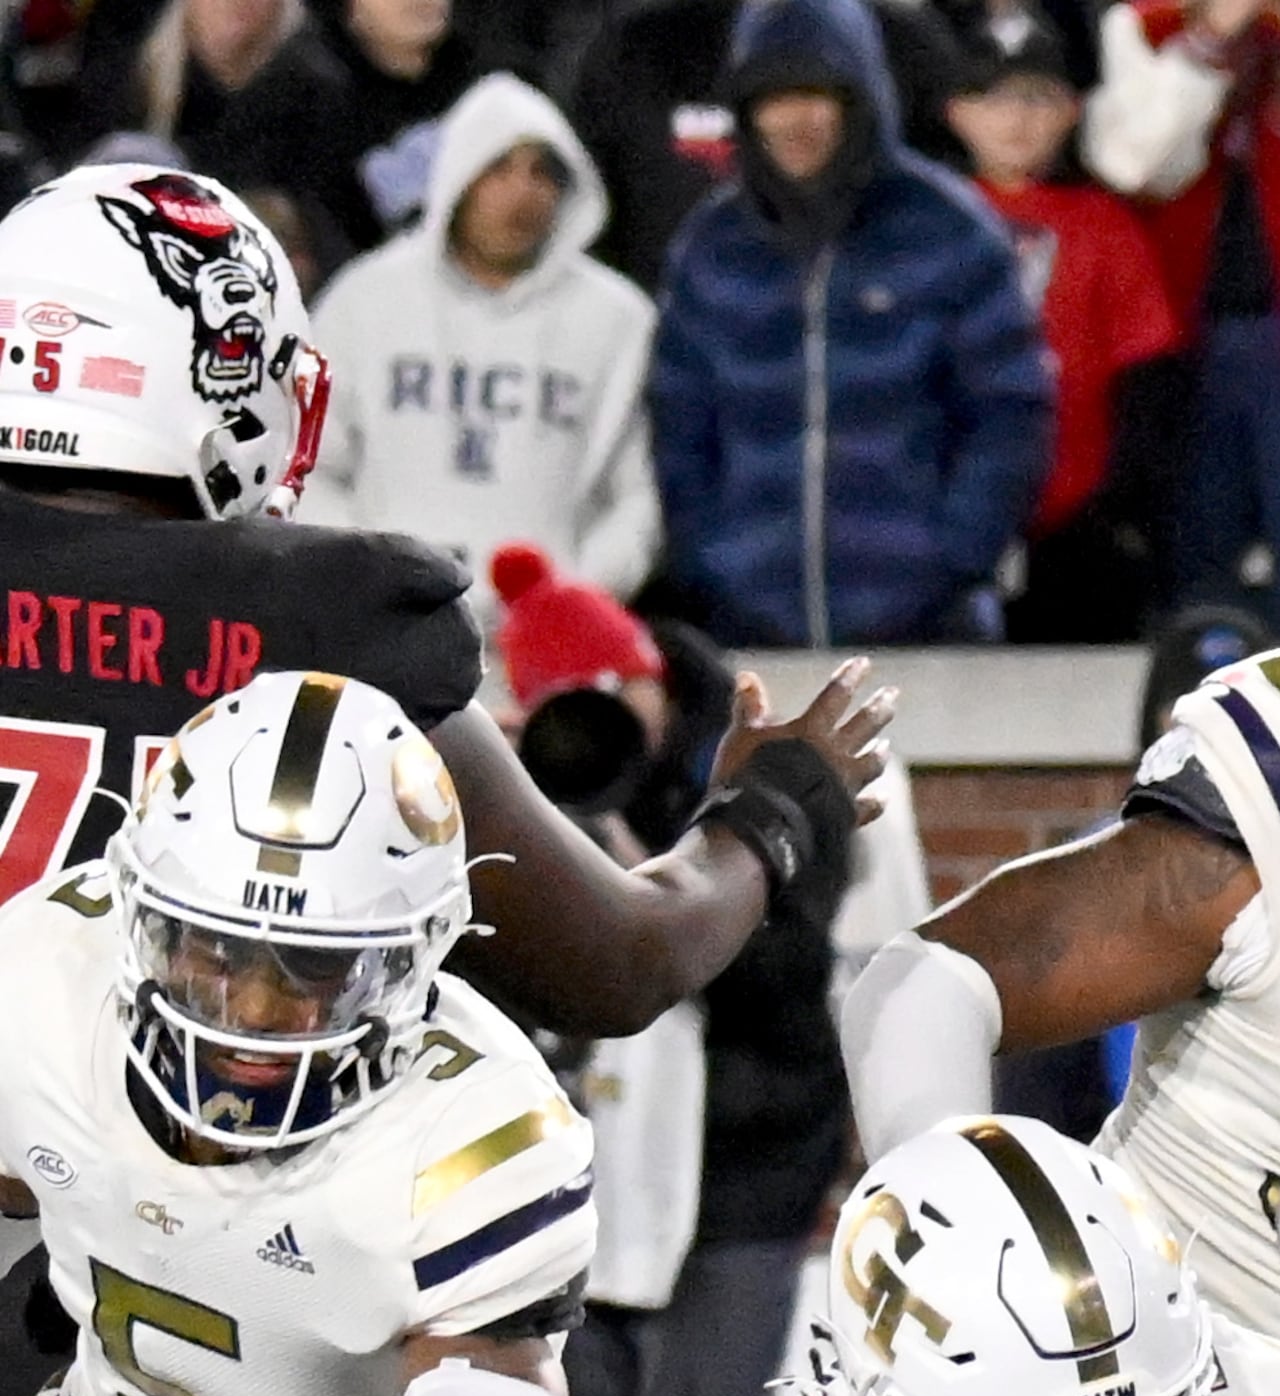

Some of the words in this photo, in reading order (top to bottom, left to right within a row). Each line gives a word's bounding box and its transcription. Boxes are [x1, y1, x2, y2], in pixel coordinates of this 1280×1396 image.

[390, 361, 584, 432] RICE
[0, 590, 164, 687] RTER
[242, 879, 309, 915] UATW
[256, 1247, 316, 1276] adidas
